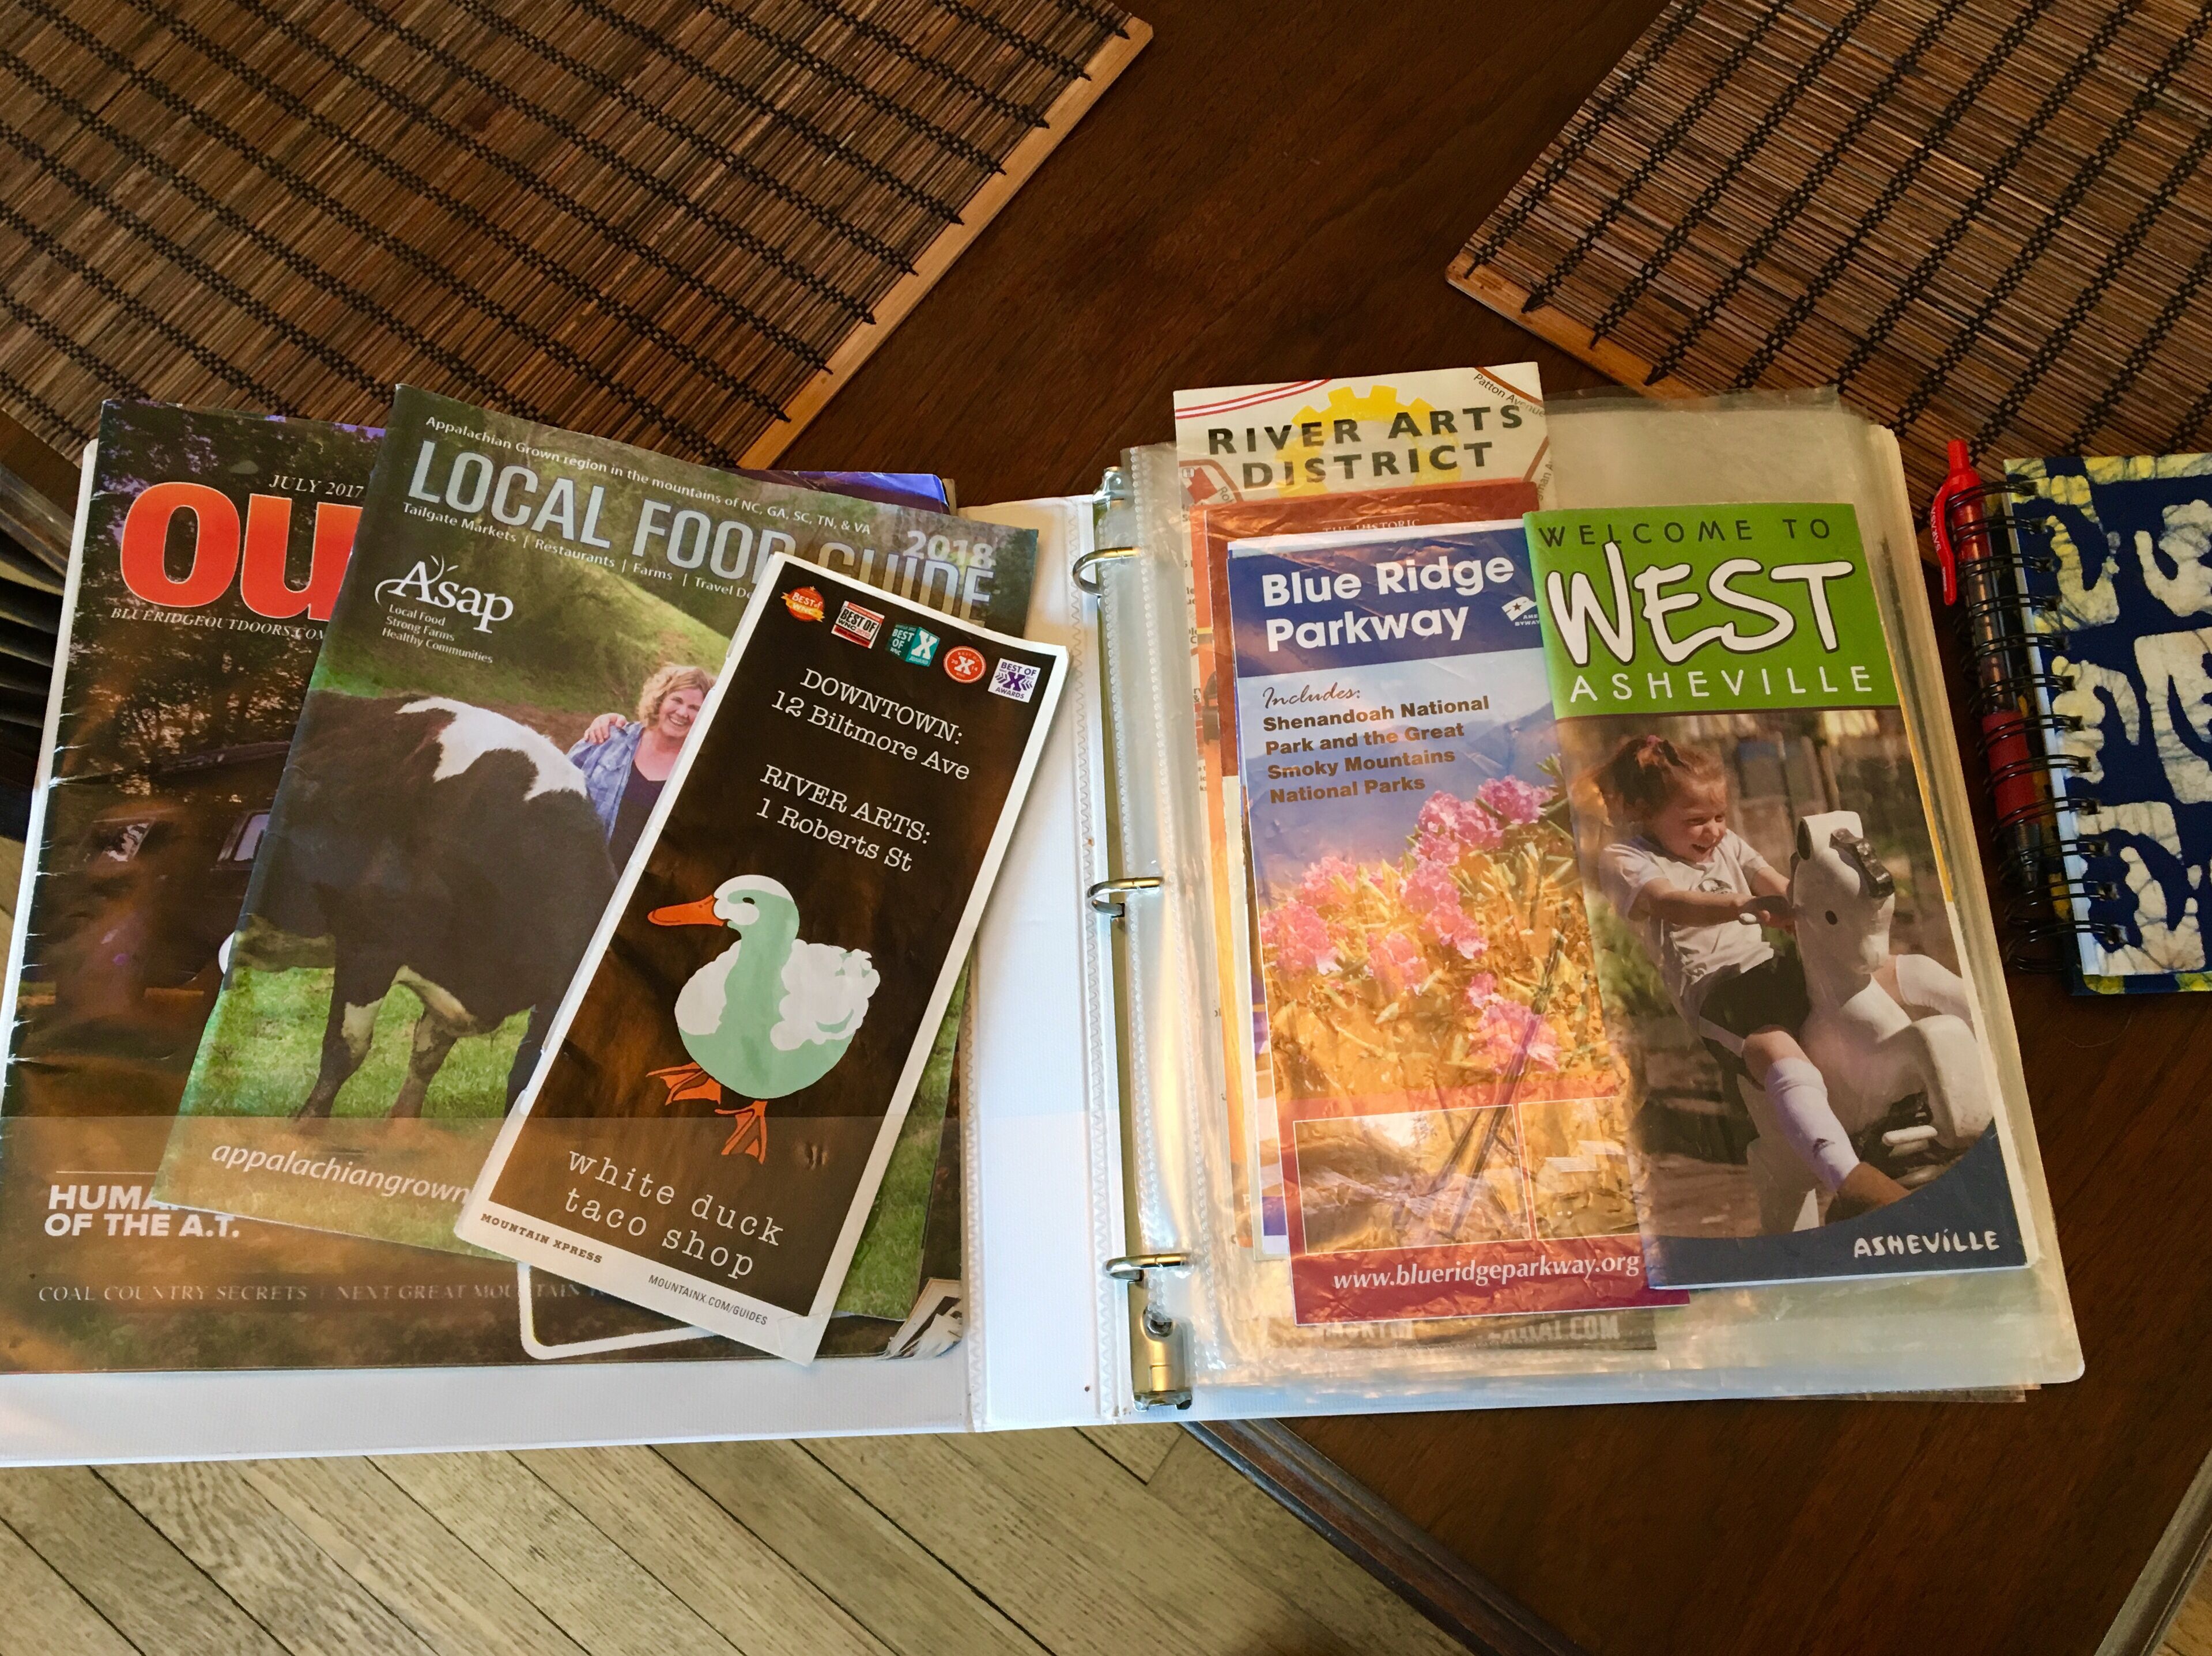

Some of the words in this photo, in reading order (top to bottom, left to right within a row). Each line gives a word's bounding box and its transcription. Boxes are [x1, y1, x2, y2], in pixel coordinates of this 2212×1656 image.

[1474, 373, 1505, 398] Patton
[1506, 394, 1545, 417] Avenue
[1209, 419, 1361, 455] RIVER
[1388, 404, 1523, 438] ARTS
[425, 416, 511, 449] Appalachian
[516, 443, 559, 462] Grown
[564, 456, 606, 472] region
[610, 466, 623, 477] in
[626, 470, 648, 484] the
[652, 478, 721, 504] mountains
[724, 495, 738, 506] of
[741, 500, 763, 515] NC,
[767, 506, 788, 520] GA,
[793, 511, 813, 524] SC,
[817, 515, 837, 529] TN,
[841, 520, 850, 531] &
[854, 523, 870, 535] VA
[1242, 441, 1492, 490] DISTRICT
[269, 474, 323, 492] JULY
[325, 482, 364, 498] 2017
[407, 440, 611, 549] LOCAL
[632, 499, 797, 584] FOOD
[403, 502, 458, 525] Tailgate
[461, 518, 516, 542] Markets
[535, 539, 616, 568] Restaurants
[633, 563, 673, 580] Farms
[695, 577, 733, 595] Travel
[903, 530, 996, 568] 2018
[1538, 519, 1753, 547] WELCOME
[1783, 519, 1830, 539] TO
[1262, 571, 1362, 607] Blue
[1376, 557, 1515, 598] Ridge
[389, 604, 417, 619] Local
[420, 611, 446, 626] Food
[840, 608, 865, 627] BEST
[863, 620, 877, 632] OF
[1545, 540, 1855, 668] WEST
[386, 616, 421, 634] Strong
[423, 626, 455, 641] Farms
[838, 619, 856, 631] WNC
[892, 629, 915, 642] BEST
[892, 638, 905, 649] OF
[1266, 606, 1469, 652] Parkway
[382, 627, 423, 648] Healthy
[426, 639, 493, 663] Communities
[1001, 661, 1022, 673] BEST
[1024, 668, 1037, 676] OF
[1570, 666, 1872, 703] ASHEVILLE
[800, 668, 963, 745] DOWNTOWN:
[995, 687, 1024, 700] AWARDS
[1262, 682, 1361, 709] Includes:
[1263, 705, 1394, 732] Shenandoah
[1401, 695, 1489, 718] National
[771, 690, 805, 718] 12
[807, 705, 918, 761] Biltmore
[921, 751, 970, 780] Ave
[1265, 738, 1314, 756] Park
[1320, 733, 1358, 750] and
[1364, 729, 1399, 746] the
[1405, 723, 1464, 742] Great
[1267, 761, 1339, 780] Smoky
[1345, 748, 1456, 772] Mountains
[760, 764, 848, 813] RIVER
[850, 802, 931, 845] ARTS:
[1270, 781, 1358, 804] National
[1364, 776, 1426, 795] Parks
[756, 798, 769, 819] 1
[777, 805, 879, 859] Roberts
[884, 846, 913, 872] St
[569, 1150, 675, 1205] white
[691, 1194, 784, 1246] duck
[44, 1213, 92, 1237] OF
[103, 1213, 171, 1237] THE
[179, 1213, 240, 1238] A.T.
[480, 1213, 550, 1245] MOUNTAIN
[553, 1239, 603, 1264] XPRESS
[565, 1188, 647, 1237] taco
[662, 1228, 753, 1279] shop
[1333, 1253, 1641, 1291] www.blueridgeparkway.org
[39, 1286, 95, 1302] COAL
[104, 1286, 208, 1300] COUNTRY
[216, 1286, 308, 1300] SECRETS
[337, 1285, 393, 1300] NEXT
[399, 1284, 467, 1299] GREAT
[473, 1284, 580, 1299] MOUTAIN
[648, 1274, 768, 1326] MOUNTAINX.COM/GUIDES
